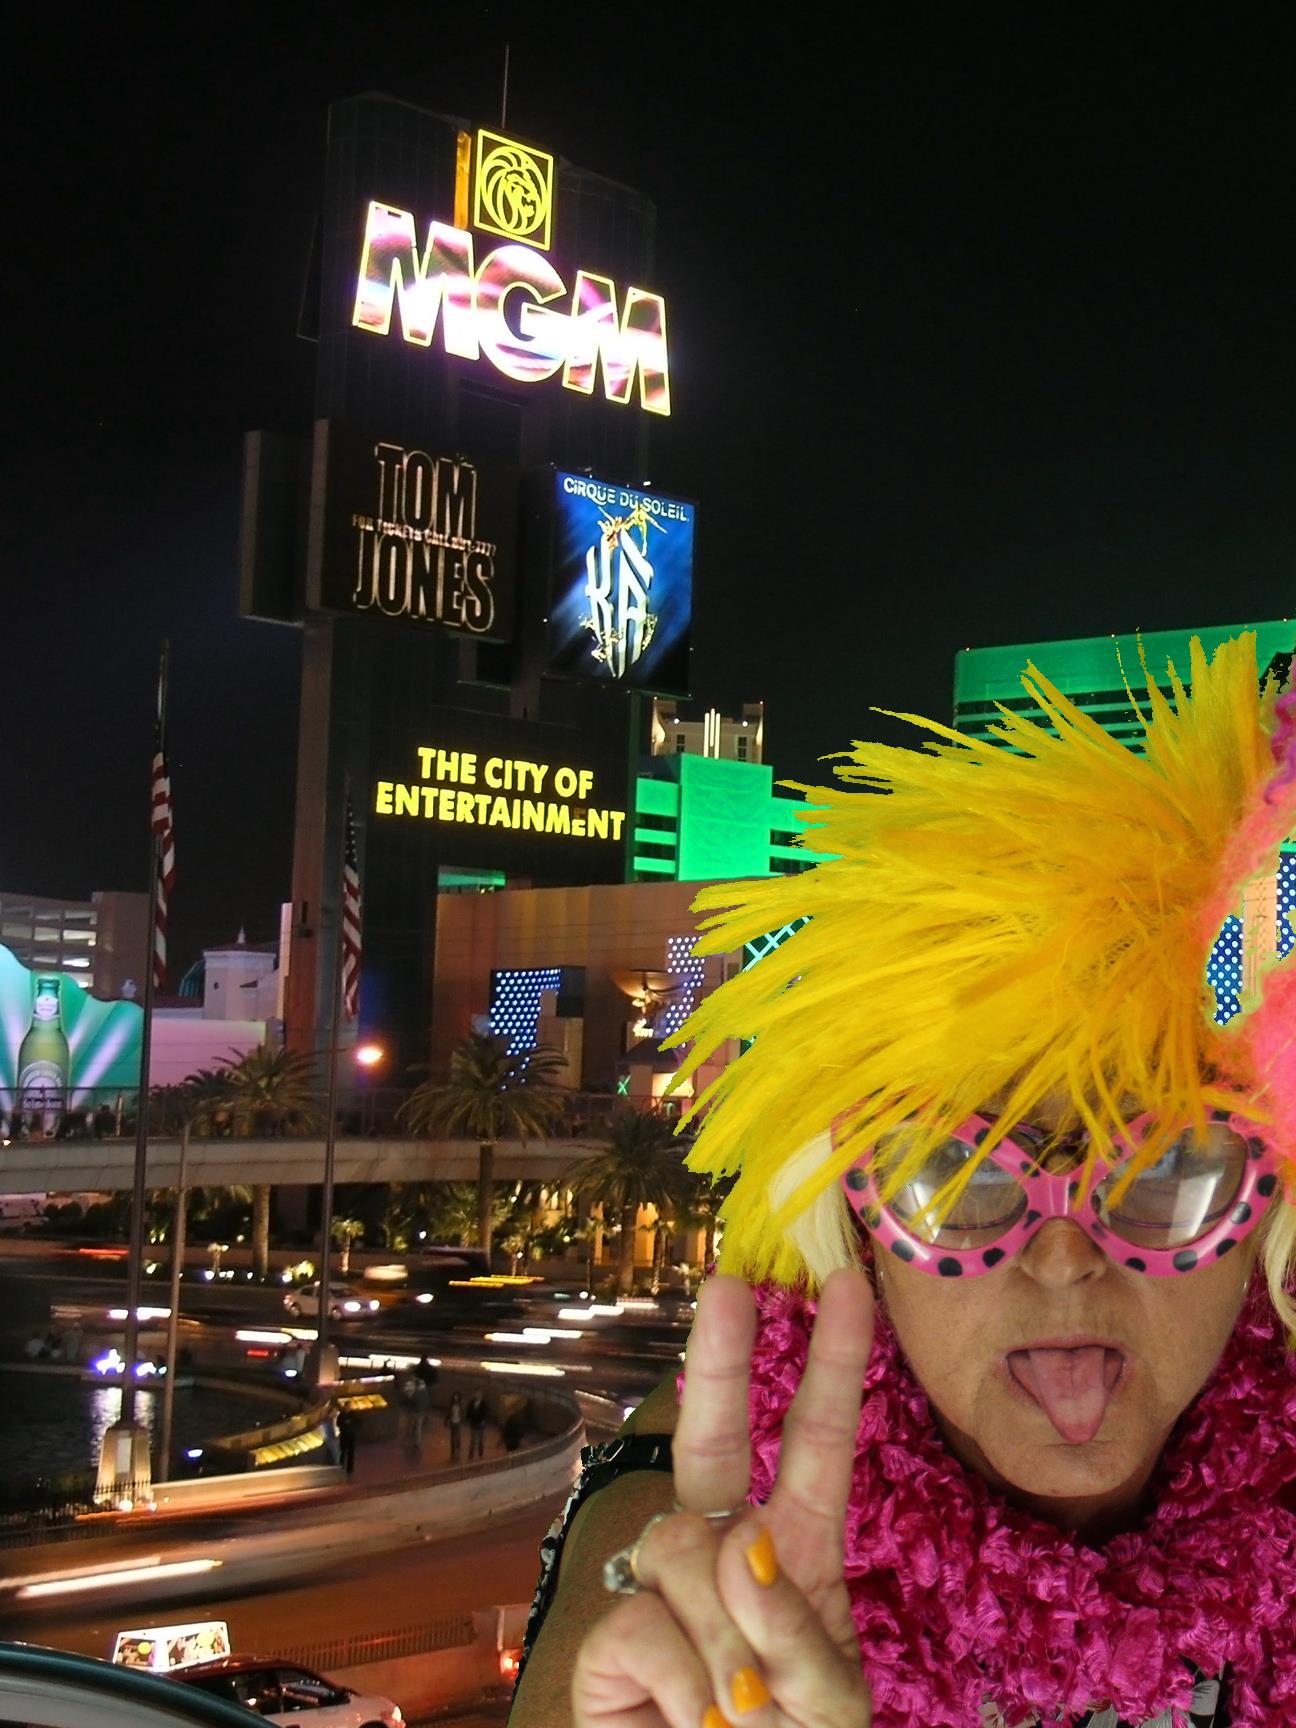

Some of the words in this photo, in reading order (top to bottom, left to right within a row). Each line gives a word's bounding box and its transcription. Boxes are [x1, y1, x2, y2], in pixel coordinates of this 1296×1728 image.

[352, 200, 672, 416] MGM
[374, 442, 477, 539] TOM
[563, 477, 616, 506] CIRQUE
[619, 492, 640, 509] DU
[641, 497, 688, 522] SOLEIL
[353, 530, 496, 632] JONES
[375, 780, 626, 841] ENTERTAINMENT
[417, 746, 478, 785] THE
[484, 757, 549, 794] CITY
[554, 766, 594, 800] OF
